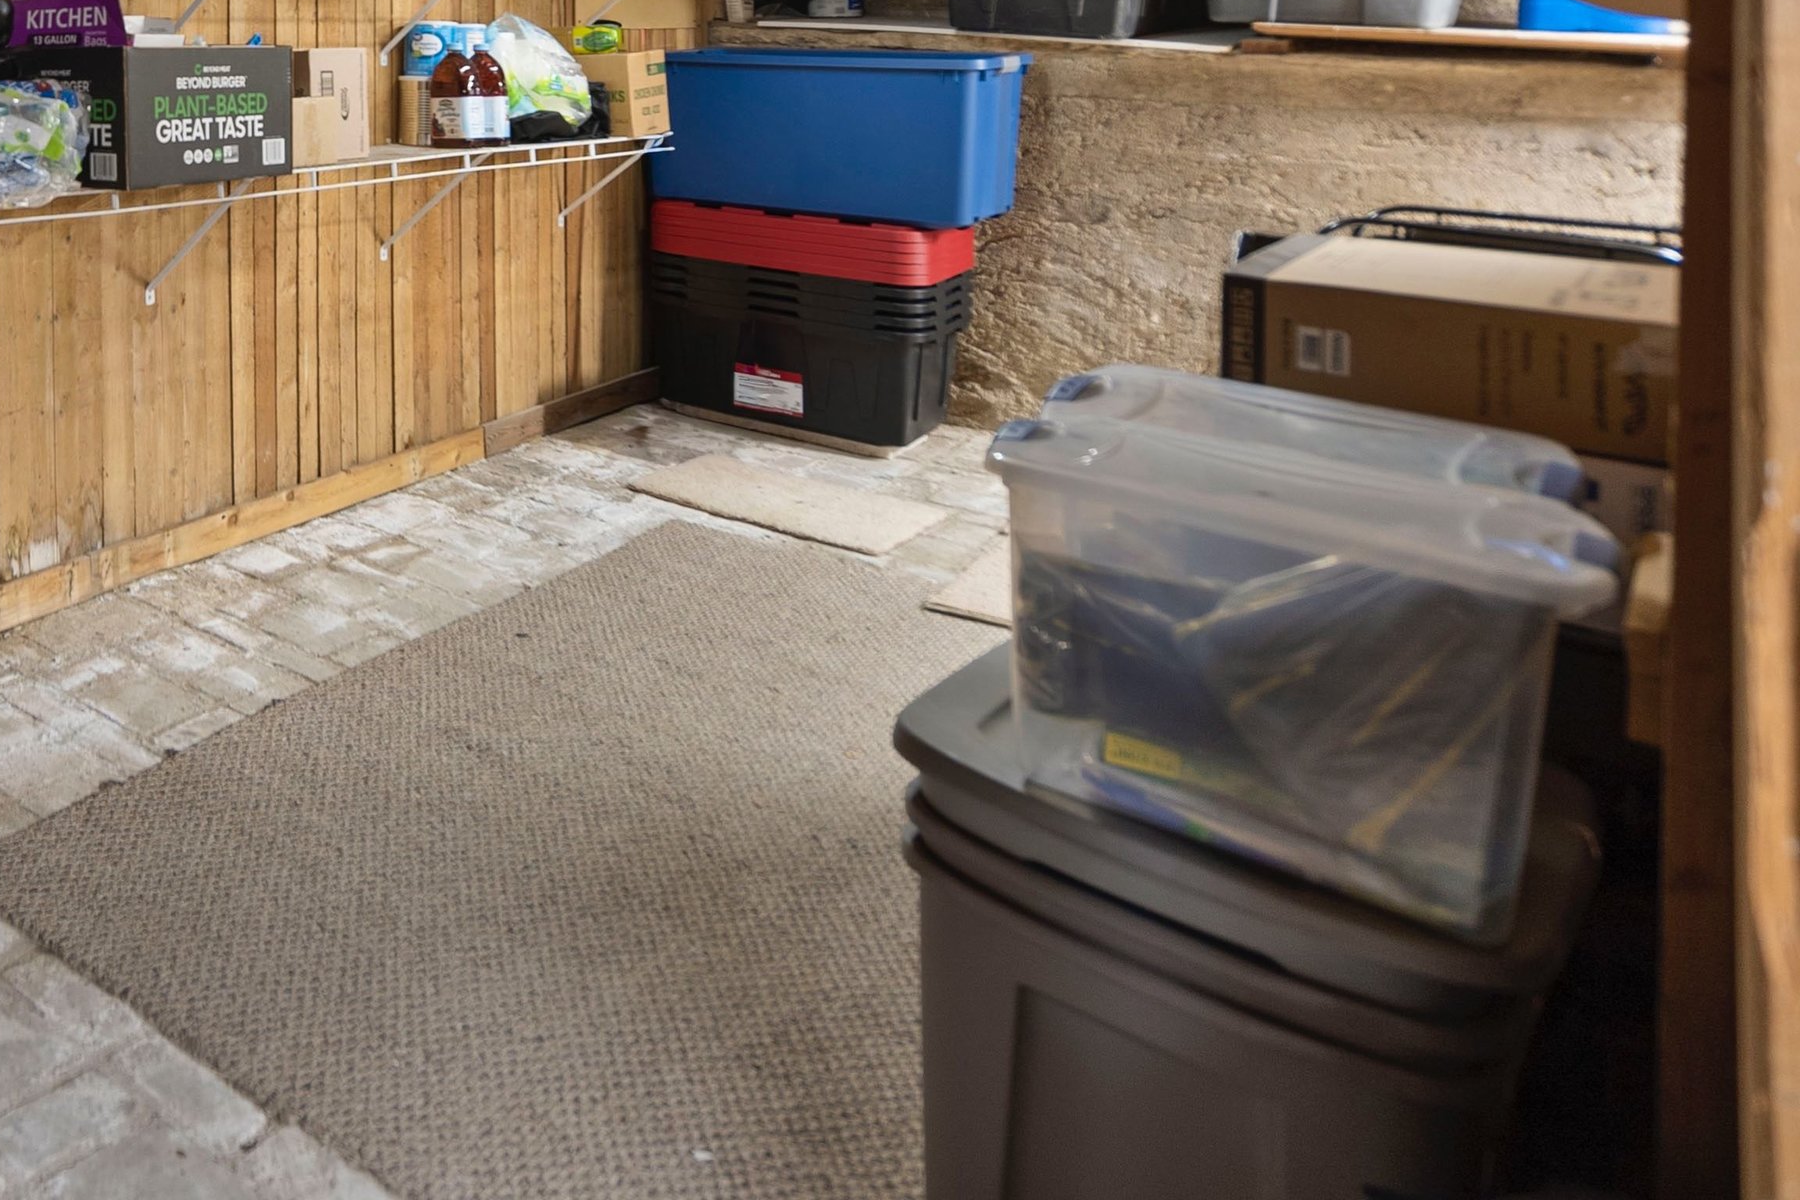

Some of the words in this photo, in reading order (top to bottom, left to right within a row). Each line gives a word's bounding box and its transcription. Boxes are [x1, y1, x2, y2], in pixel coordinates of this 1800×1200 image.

[26, 6, 108, 30] KITCHEN
[33, 36, 42, 45] 13
[44, 35, 77, 44] GALLON
[176, 77, 211, 90] BEYOND
[212, 76, 246, 88] BURGER
[154, 93, 268, 119] PLANT-BASED
[156, 117, 213, 143] GREAT
[215, 115, 264, 139] TASTE
